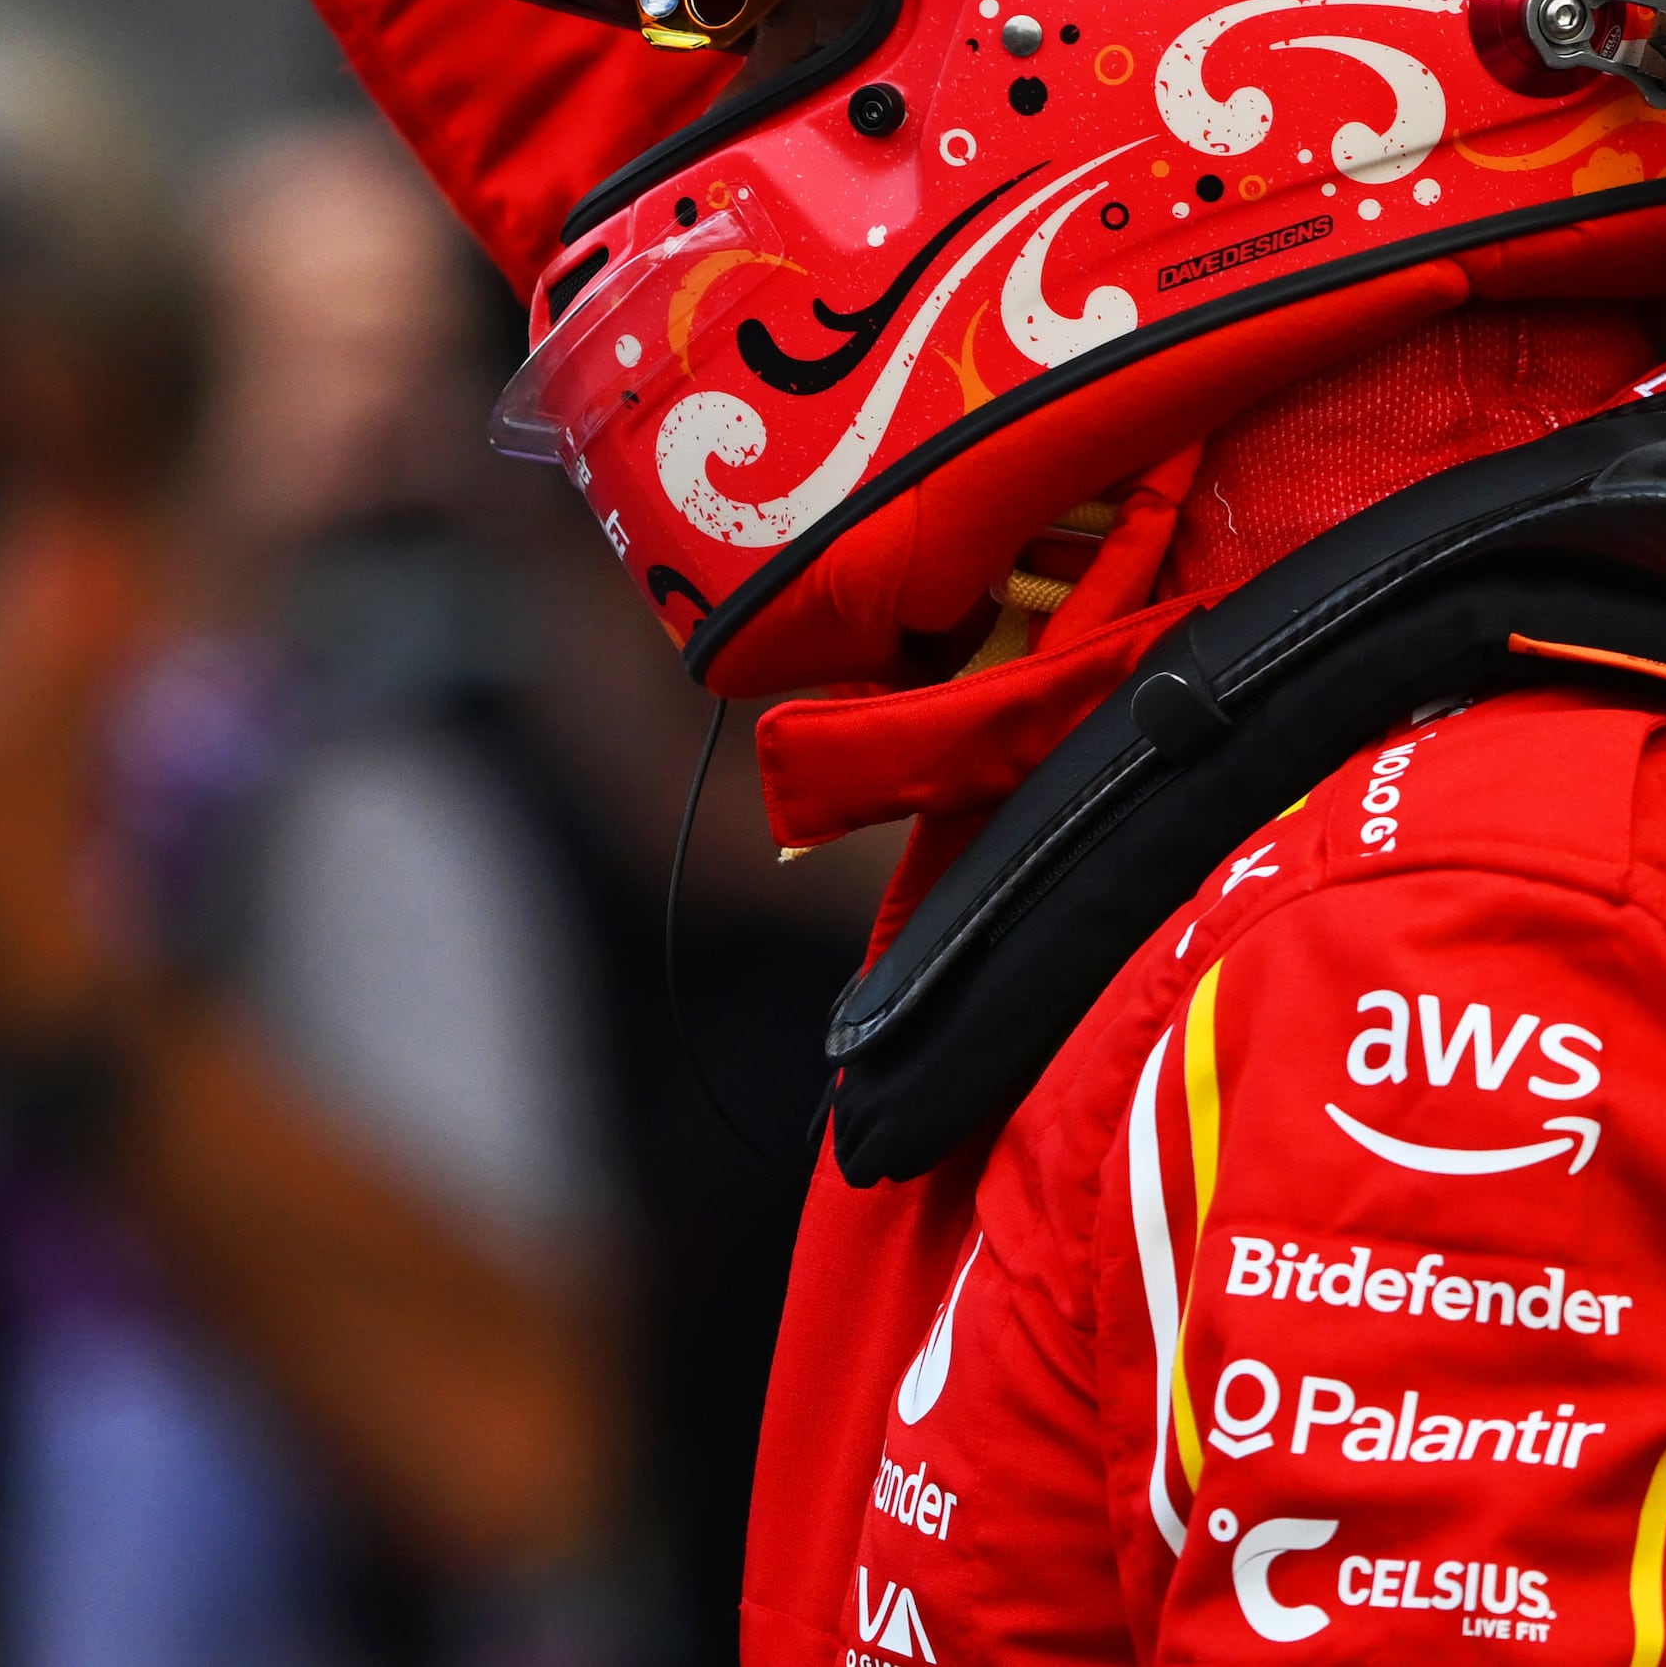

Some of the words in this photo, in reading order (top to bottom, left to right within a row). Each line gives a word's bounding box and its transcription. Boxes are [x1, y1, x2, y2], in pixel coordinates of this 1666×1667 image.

[1346, 989, 1603, 1101] aws
[1225, 1236, 1632, 1336] Bitdefender
[1290, 1374, 1606, 1470] Palantir
[1461, 1616, 1512, 1640] LIVE
[1515, 1620, 1551, 1643] FIT
